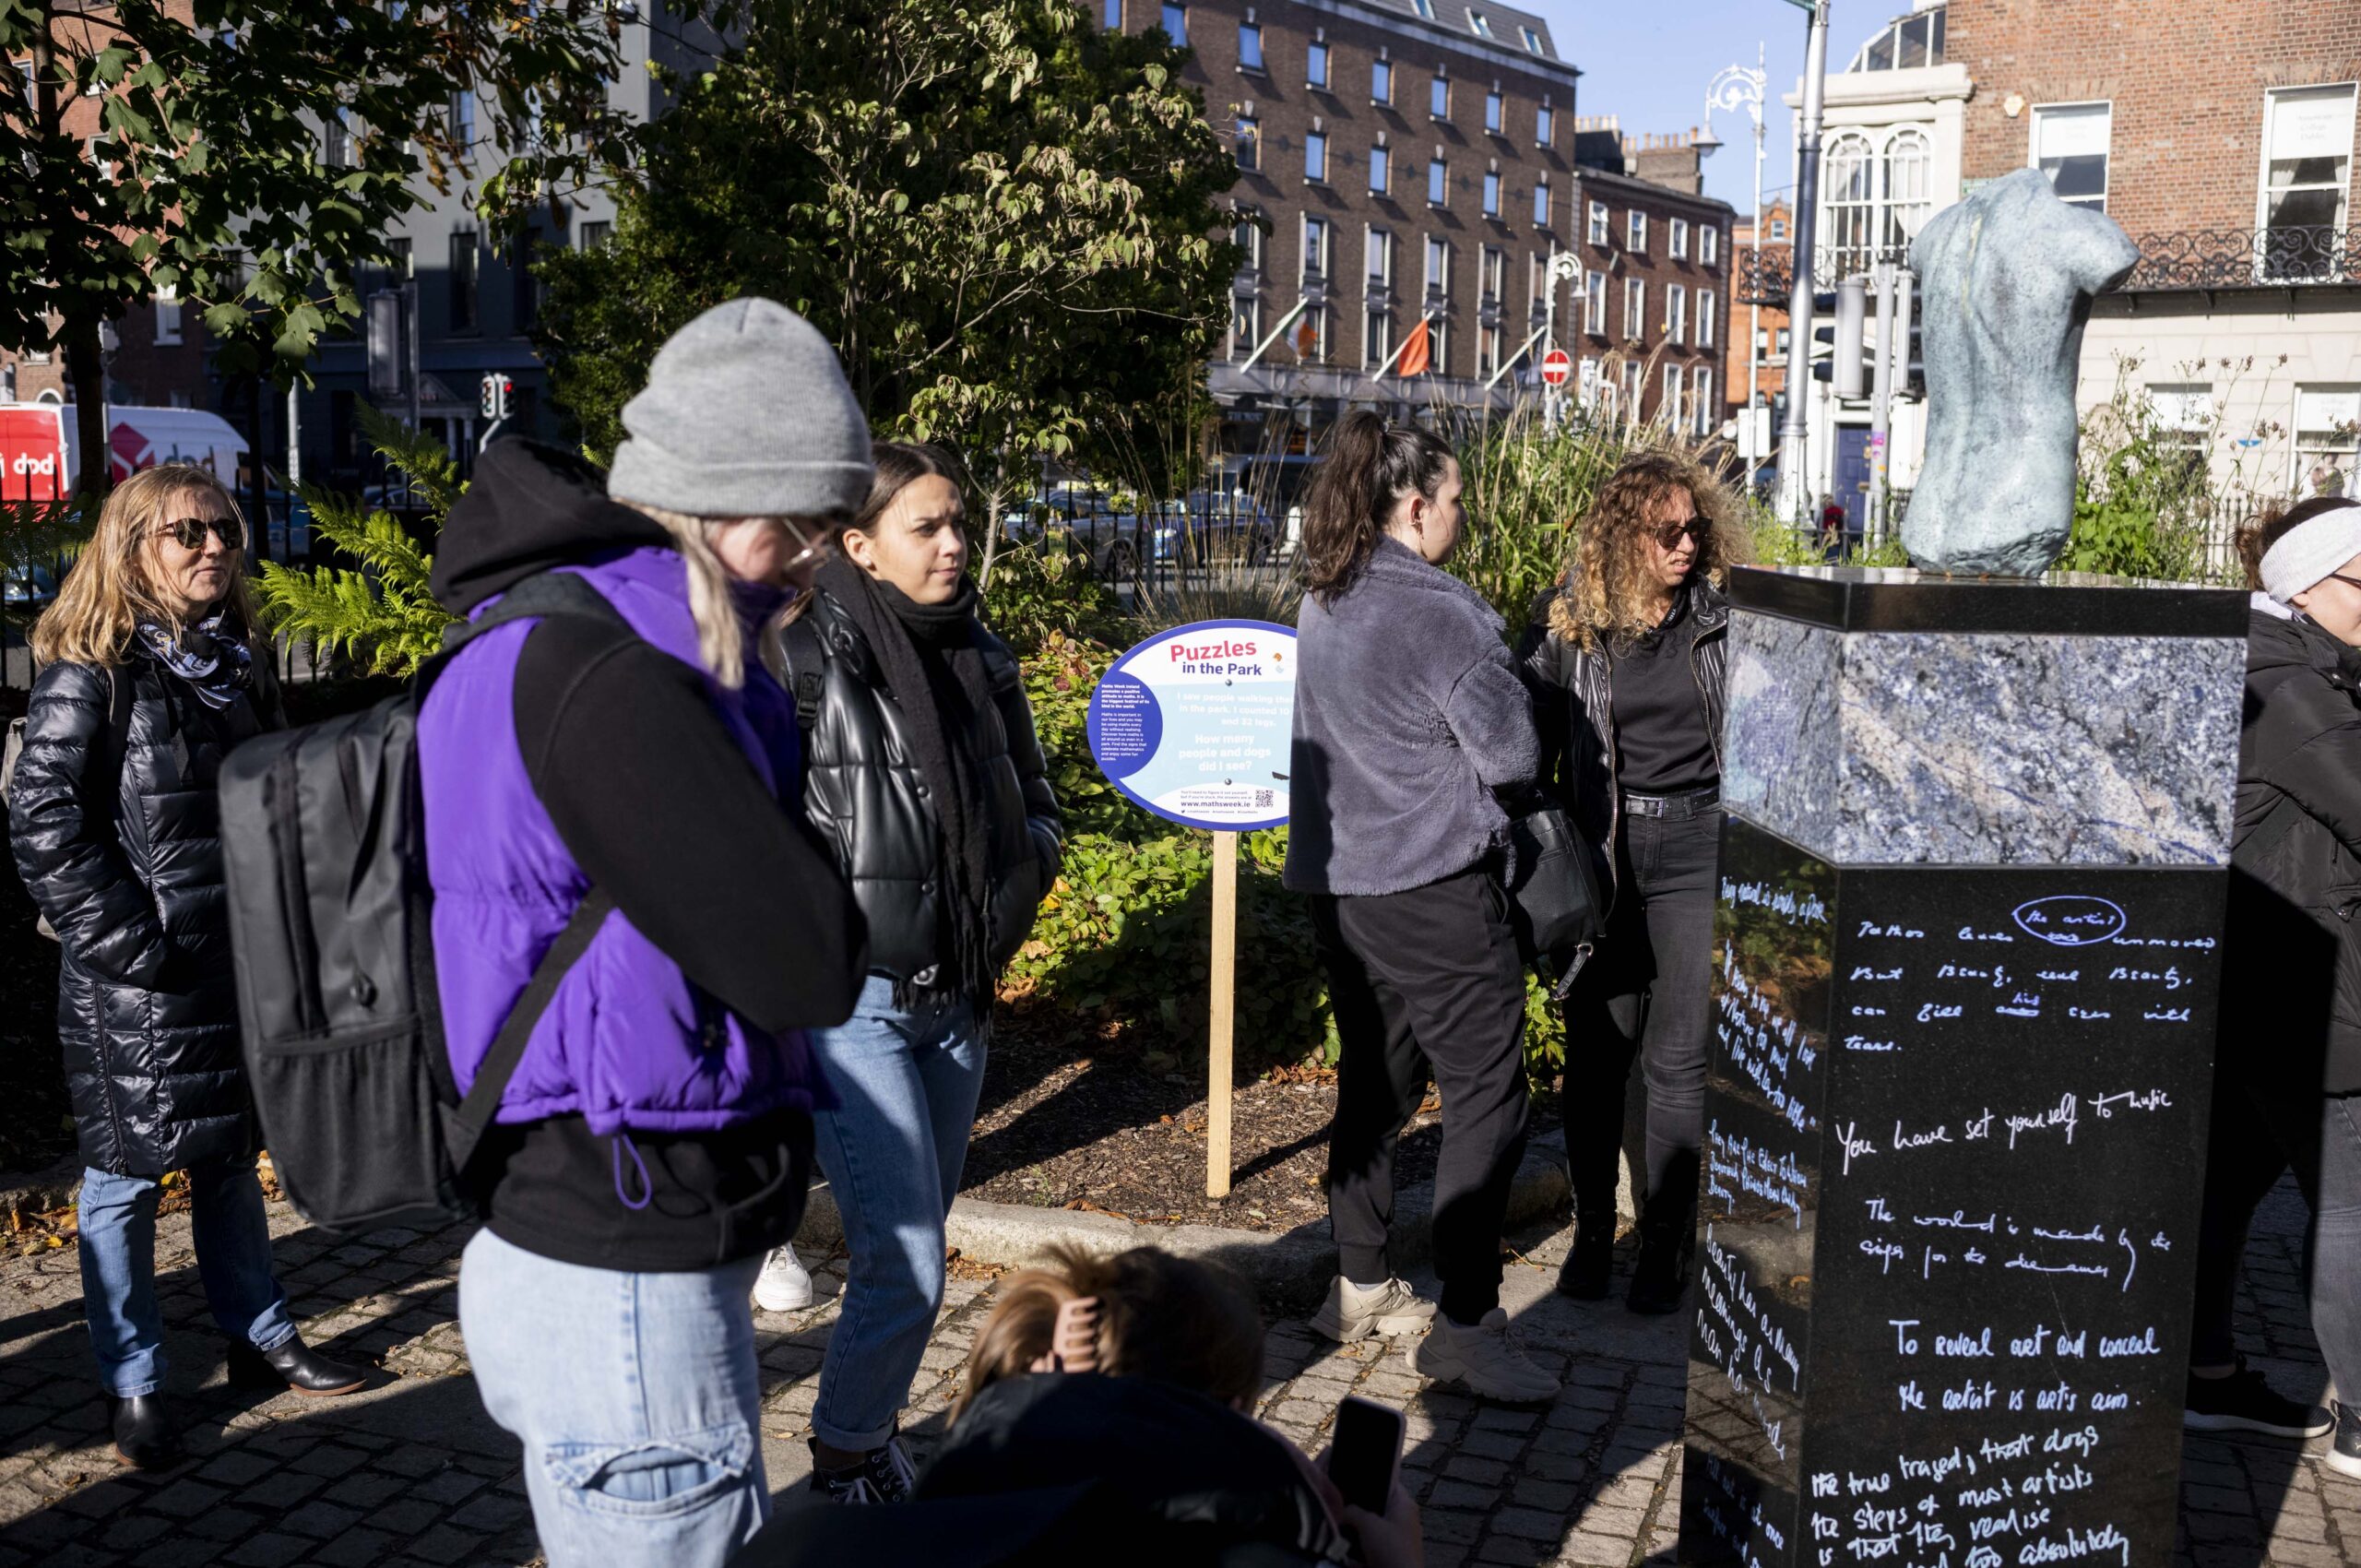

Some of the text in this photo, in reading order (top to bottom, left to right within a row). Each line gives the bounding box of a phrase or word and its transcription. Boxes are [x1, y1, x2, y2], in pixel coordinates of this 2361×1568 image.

[13, 452, 54, 475] dpd
[1170, 640, 1257, 662] Puzzles
[1182, 661, 1262, 675] in the Park
[1203, 694, 1235, 704] people
[1237, 695, 1274, 704] walking
[1194, 734, 1254, 746] How many
[1179, 747, 1271, 760] people and dogs
[1198, 761, 1216, 771] did
[1226, 761, 1252, 771] see?
[1836, 1122, 1877, 1175] You
[1894, 1121, 1952, 1149] have
[1965, 1108, 1995, 1139] set
[2005, 1093, 2078, 1149] yourself
[1866, 1198, 1894, 1221] The
[1889, 1320, 2160, 1358] To reveal art and conceal
[1942, 1379, 1997, 1410] artist
[2009, 1389, 2023, 1410] is
[1847, 1472, 1890, 1495] true
[1980, 1433, 2034, 1463] that
[2044, 1426, 2098, 1457] dogs
[1854, 1502, 1907, 1531] steps
[2023, 1462, 2092, 1494] artists
[1819, 1548, 1833, 1566] is
[1847, 1533, 1901, 1560] that
[1970, 1500, 2050, 1540] realise
